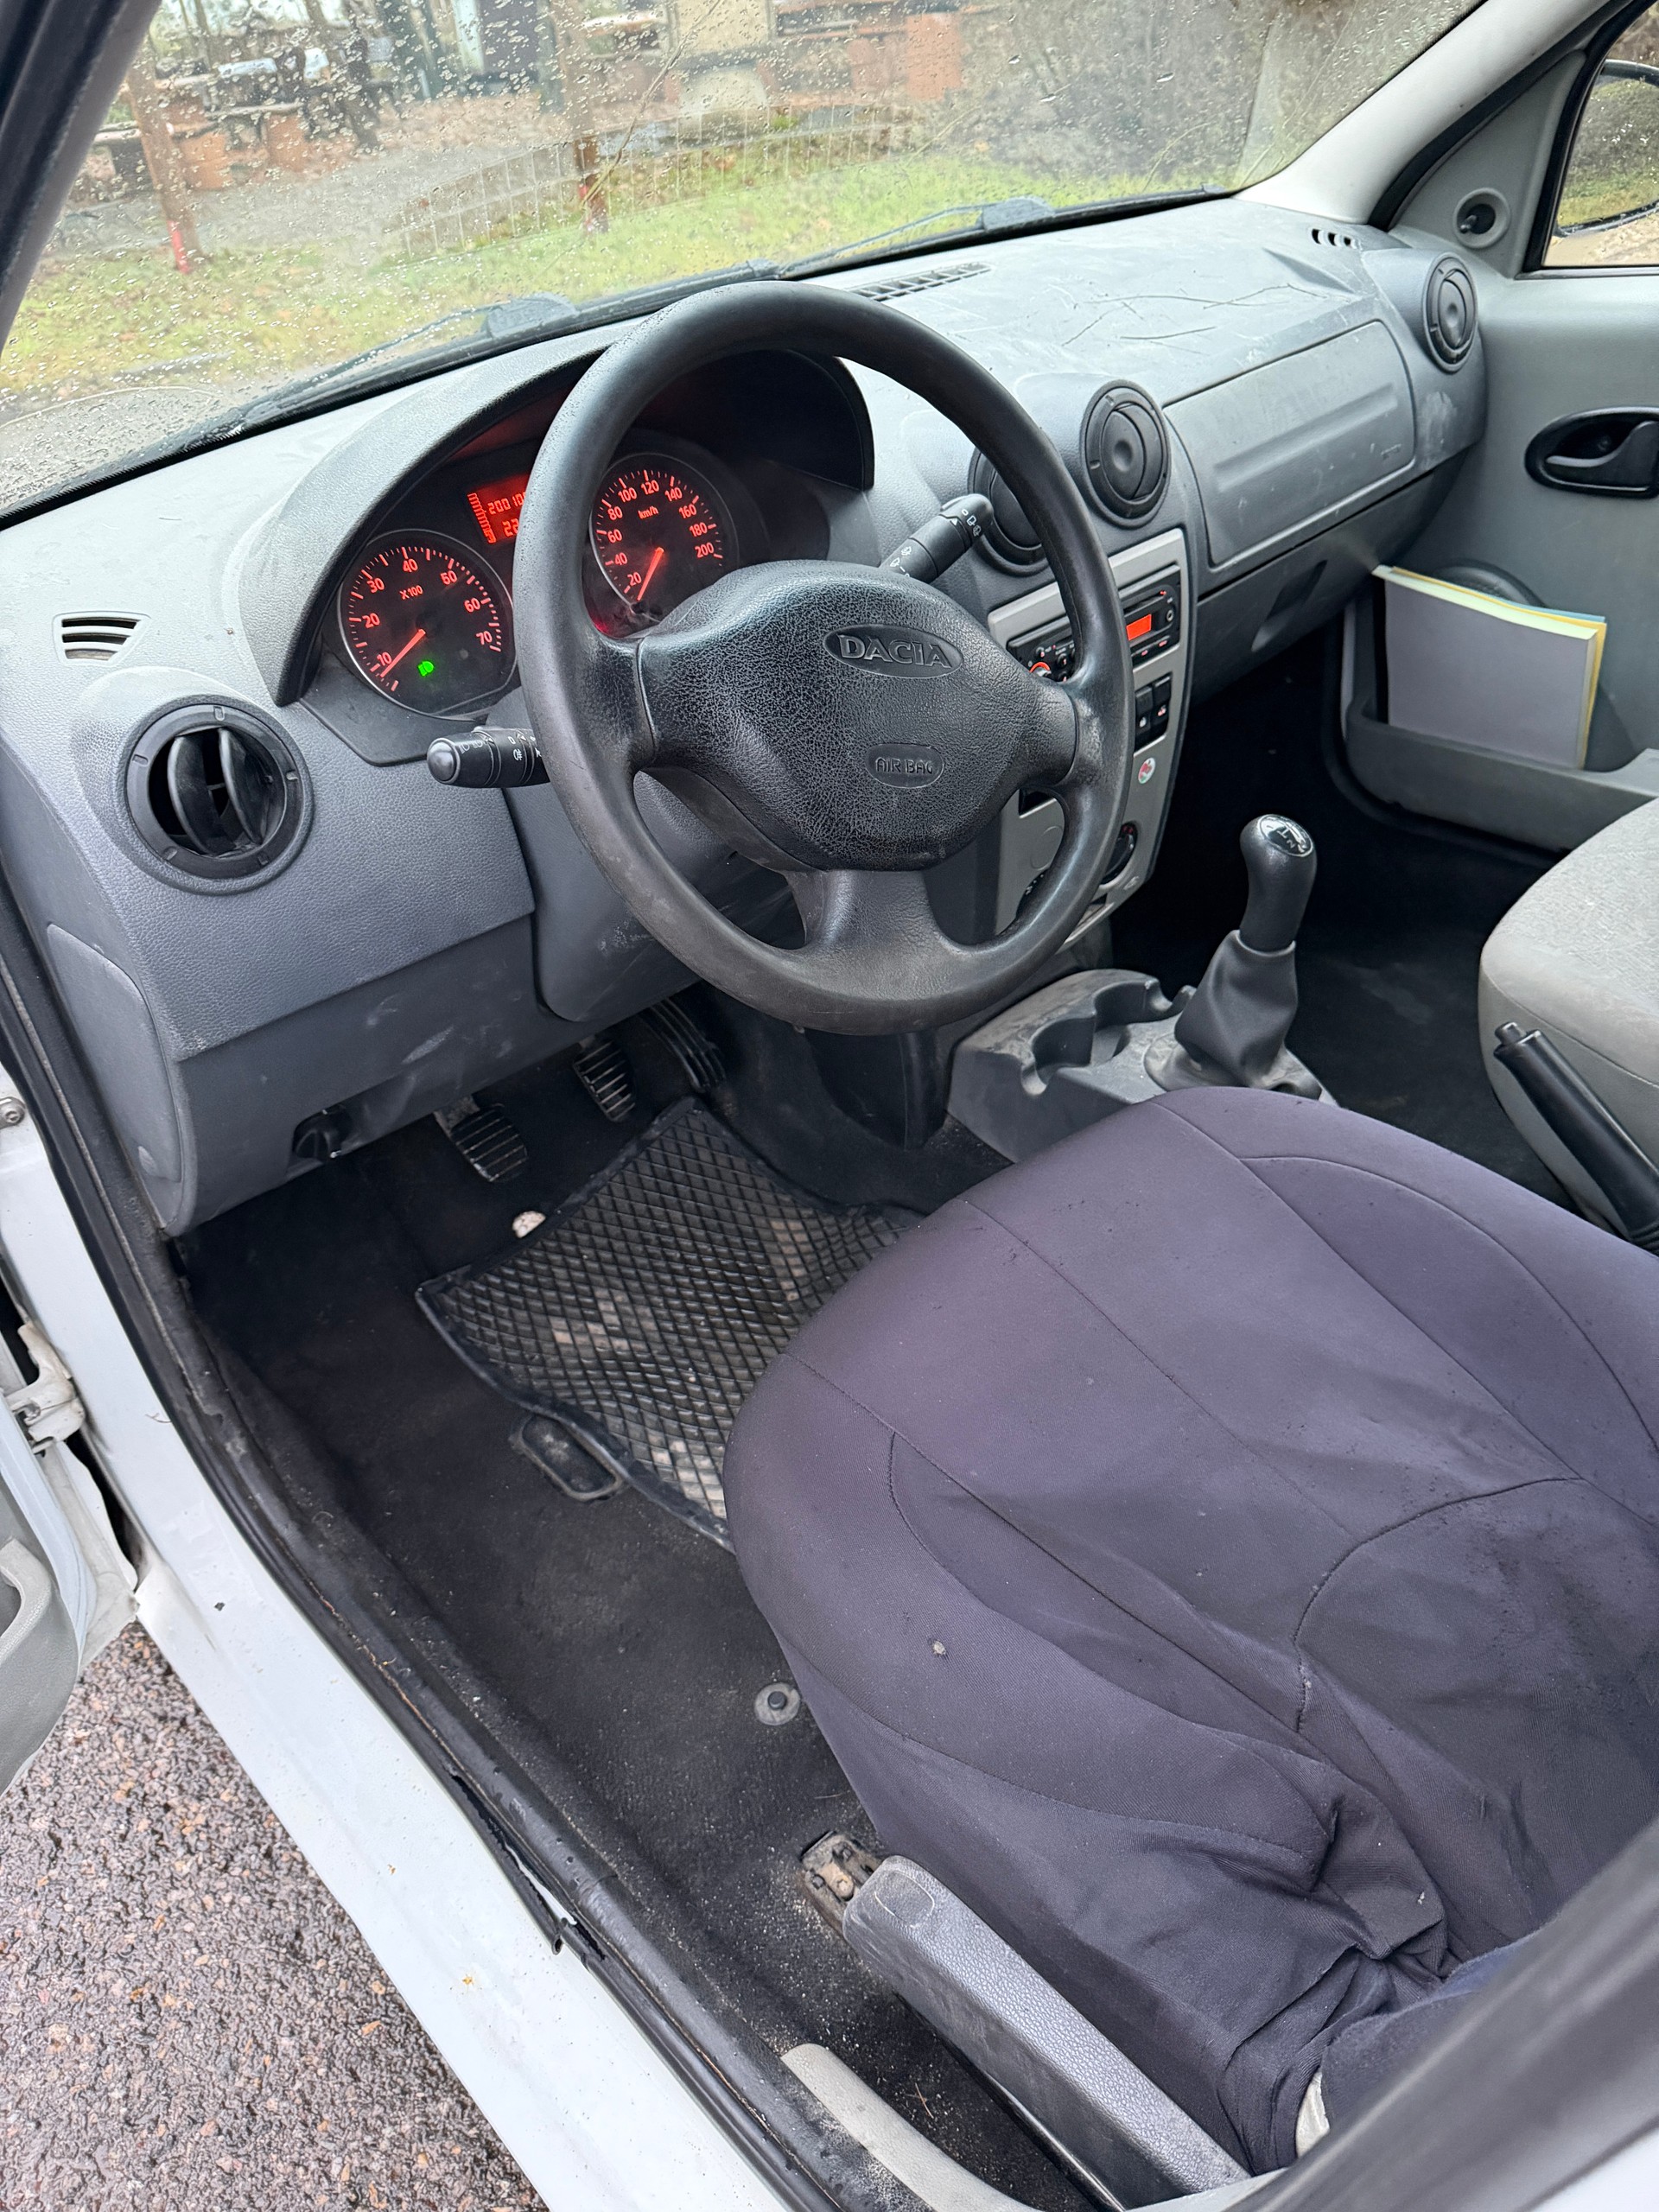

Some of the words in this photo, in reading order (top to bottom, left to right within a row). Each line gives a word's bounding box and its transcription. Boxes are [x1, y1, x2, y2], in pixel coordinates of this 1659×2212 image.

[641, 480, 659, 494] 120
[664, 487, 683, 502] 140
[618, 487, 638, 503] 100
[607, 506, 623, 520] 80
[638, 505, 658, 518] km/h
[678, 504, 697, 518] 160
[607, 529, 623, 543] 60
[689, 522, 708, 537] 180
[695, 542, 715, 559] 200
[402, 558, 419, 573] 40
[614, 552, 628, 566] 40
[366, 577, 385, 594] 30
[440, 570, 458, 586] 50
[627, 571, 642, 587] 20
[464, 597, 481, 613] 60
[362, 613, 381, 629] 20
[475, 631, 493, 645] 70
[376, 652, 392, 665] 10
[836, 633, 953, 669] DACIA
[874, 756, 900, 773] AIR
[905, 758, 934, 774] BAG
